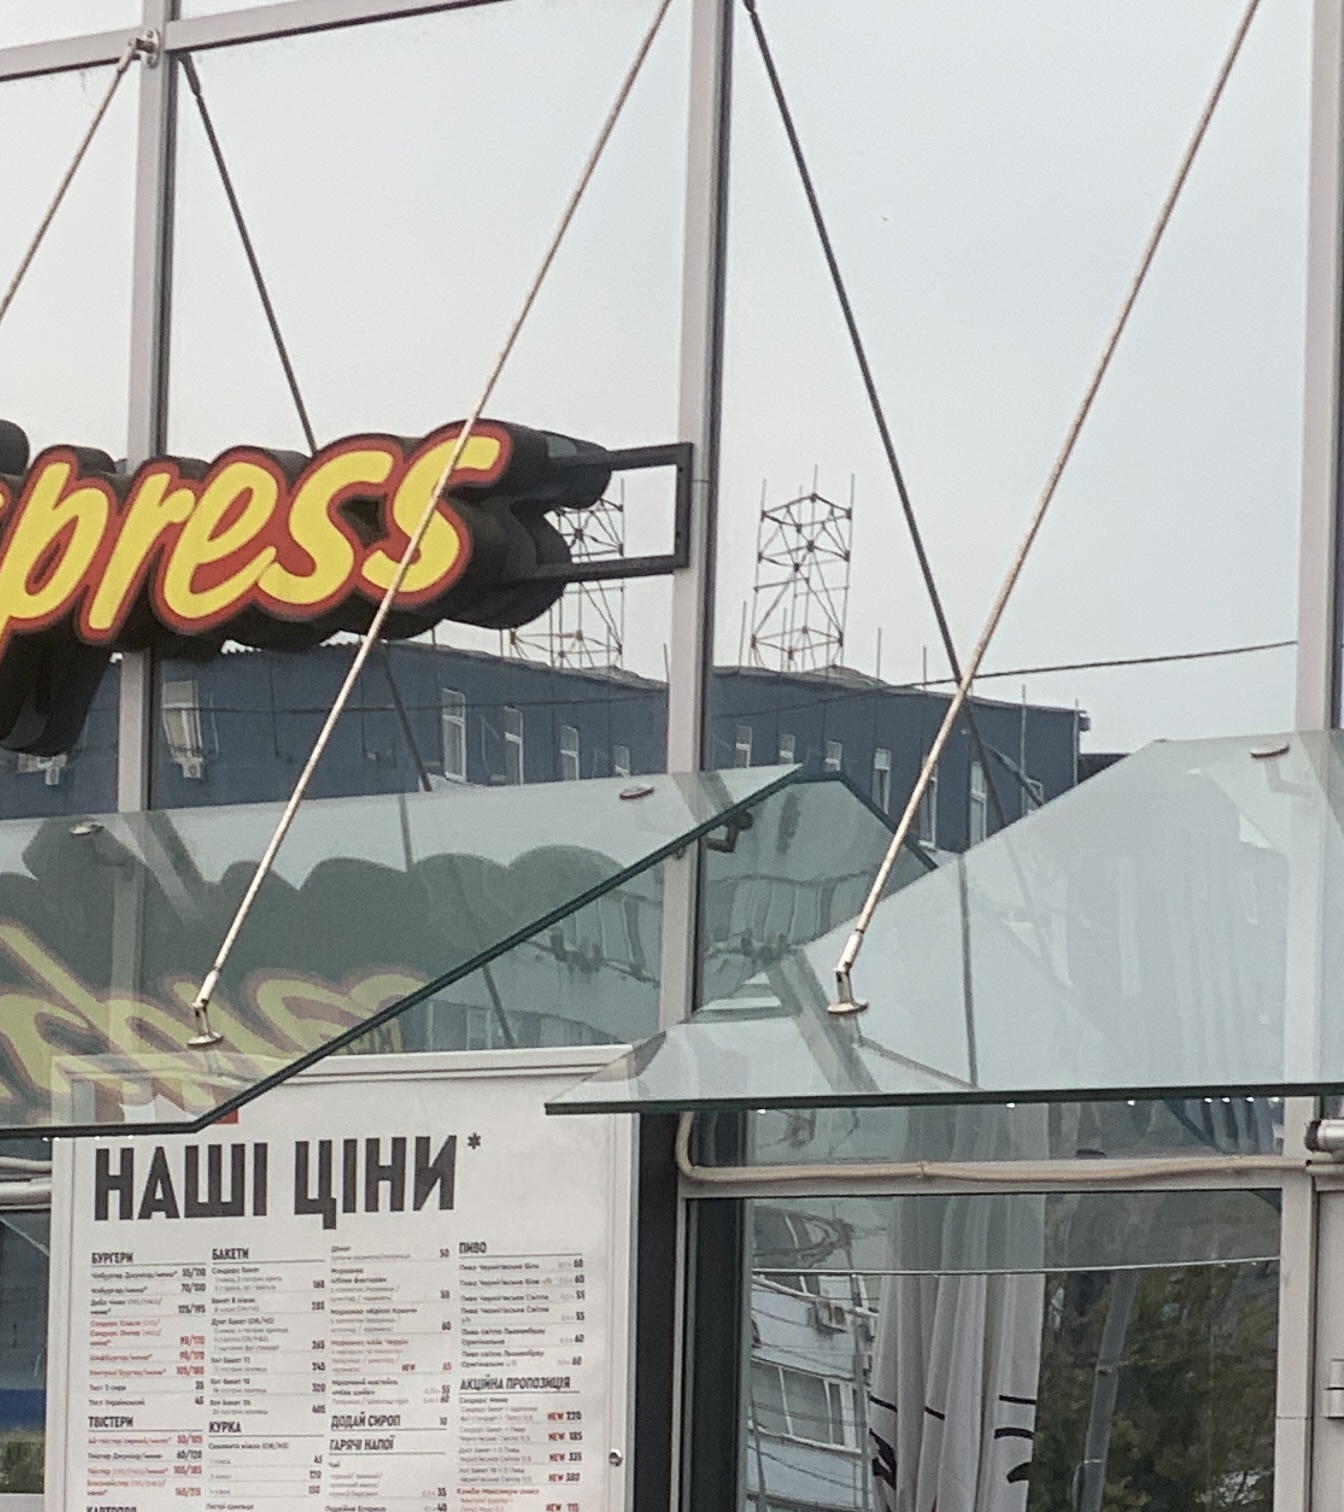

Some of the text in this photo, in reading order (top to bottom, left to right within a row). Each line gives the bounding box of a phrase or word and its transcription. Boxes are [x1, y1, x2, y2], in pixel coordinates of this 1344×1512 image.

[93, 1141, 269, 1221] НАШІ
[459, 1241, 487, 1254] ПИВО
[92, 1252, 134, 1264] БУРГЕРИ
[212, 1248, 249, 1260] БАКЕТИ
[460, 1373, 571, 1391] АКЦІЙНА ПРОПОЗИЦІЯ
[88, 1416, 134, 1428] ТВІСТЕРИ
[331, 1411, 401, 1428] ДОДАЙ СИРОП
[547, 1412, 564, 1420] NEW
[209, 1421, 242, 1433] КУРКА
[330, 1434, 396, 1451] ГАРЯЧІ НАПОЇ
[548, 1432, 565, 1441] NEW
[549, 1453, 565, 1461] NEW
[548, 1473, 564, 1482] NEW
[546, 1503, 562, 1512] NEW
